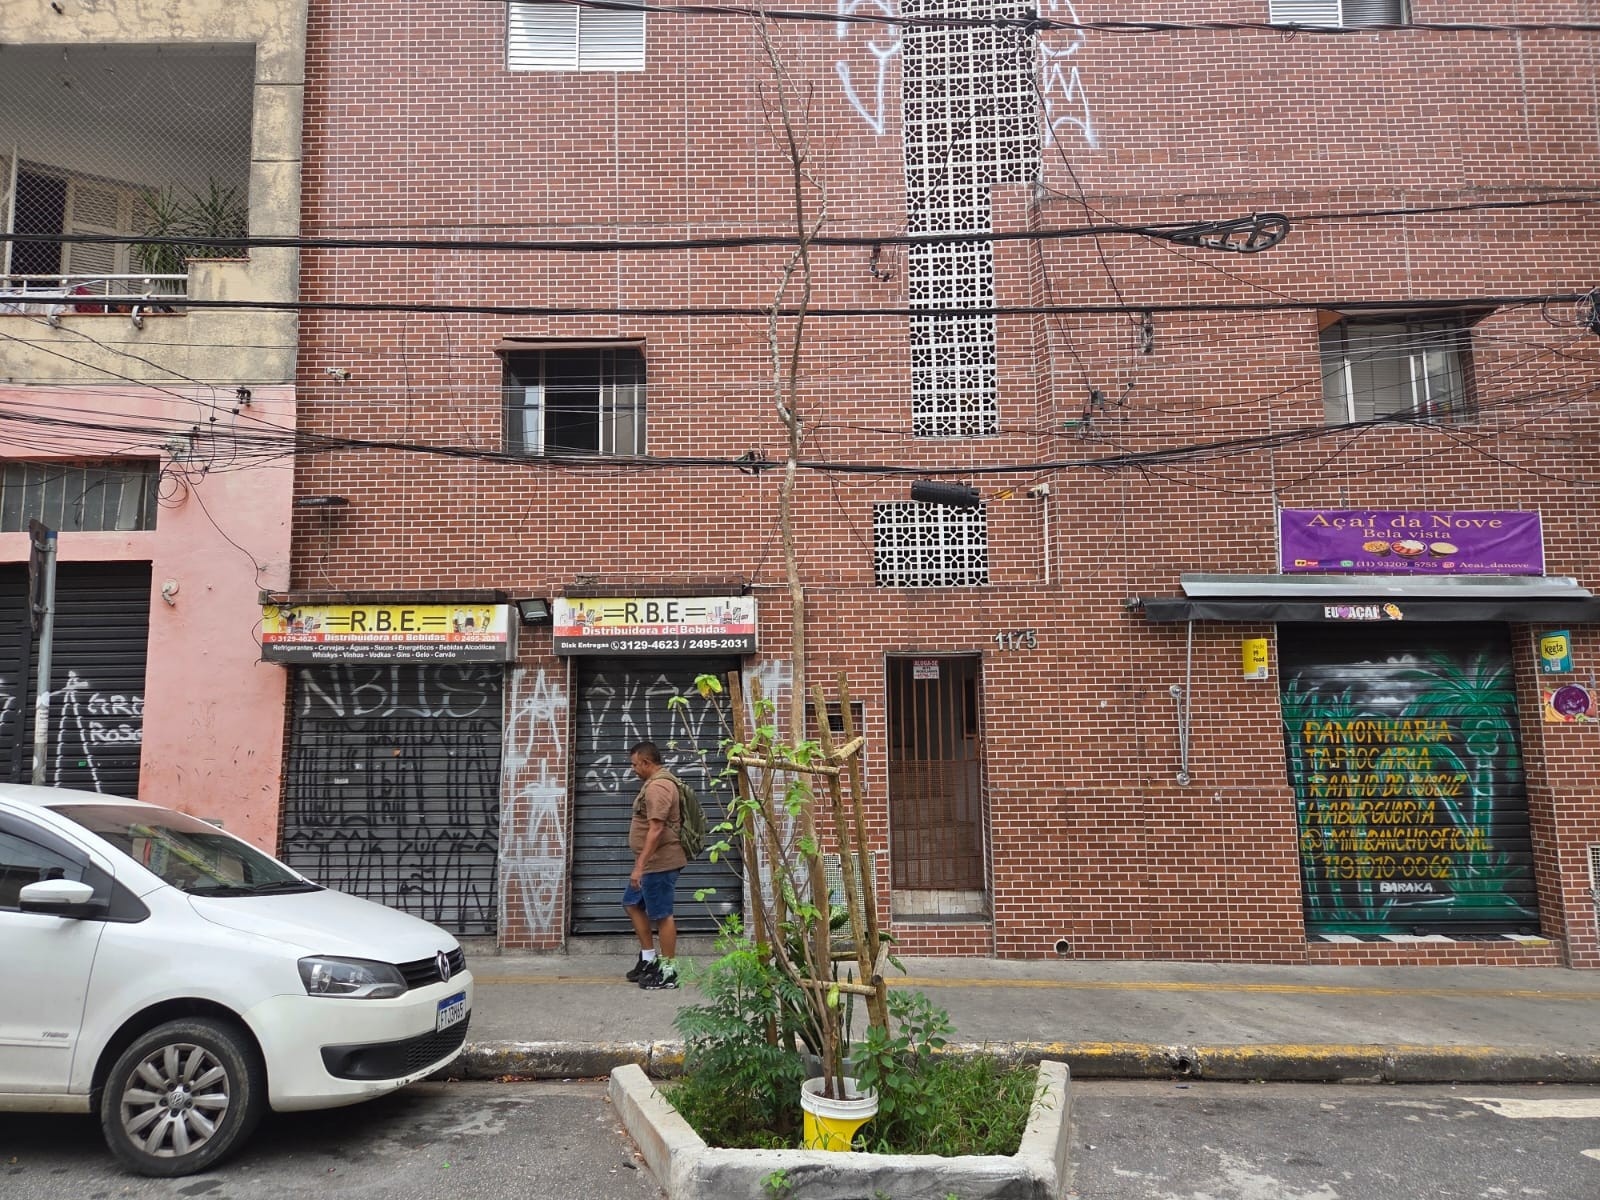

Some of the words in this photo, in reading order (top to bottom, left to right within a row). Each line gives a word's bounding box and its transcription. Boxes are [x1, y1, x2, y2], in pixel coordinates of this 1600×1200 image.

[1306, 514, 1377, 530] Açaí
[1391, 515, 1422, 528] da
[1431, 515, 1503, 529] Nove
[1363, 529, 1402, 538] Bela
[1408, 529, 1452, 539] vista
[625, 602, 685, 623] R.B.E.
[1324, 606, 1339, 618] EU
[350, 610, 421, 631] R.B.E.
[582, 626, 658, 636] Distribuidora
[662, 625, 676, 634] de
[680, 625, 727, 634] Bebidas
[324, 633, 390, 641] Distribuidora
[391, 633, 404, 641] de
[406, 633, 446, 641] Bebidas
[273, 644, 313, 652] Refrigerantes
[318, 644, 345, 652] Cervejas
[350, 643, 369, 652] Águas
[578, 642, 609, 650] Entregas
[620, 640, 679, 650] 3129-4623
[689, 639, 748, 649] 2495-2031
[1303, 720, 1452, 743] PAMONHARIA
[1305, 747, 1432, 769] TAPIOCARIA
[1380, 882, 1433, 893] BARAKA
